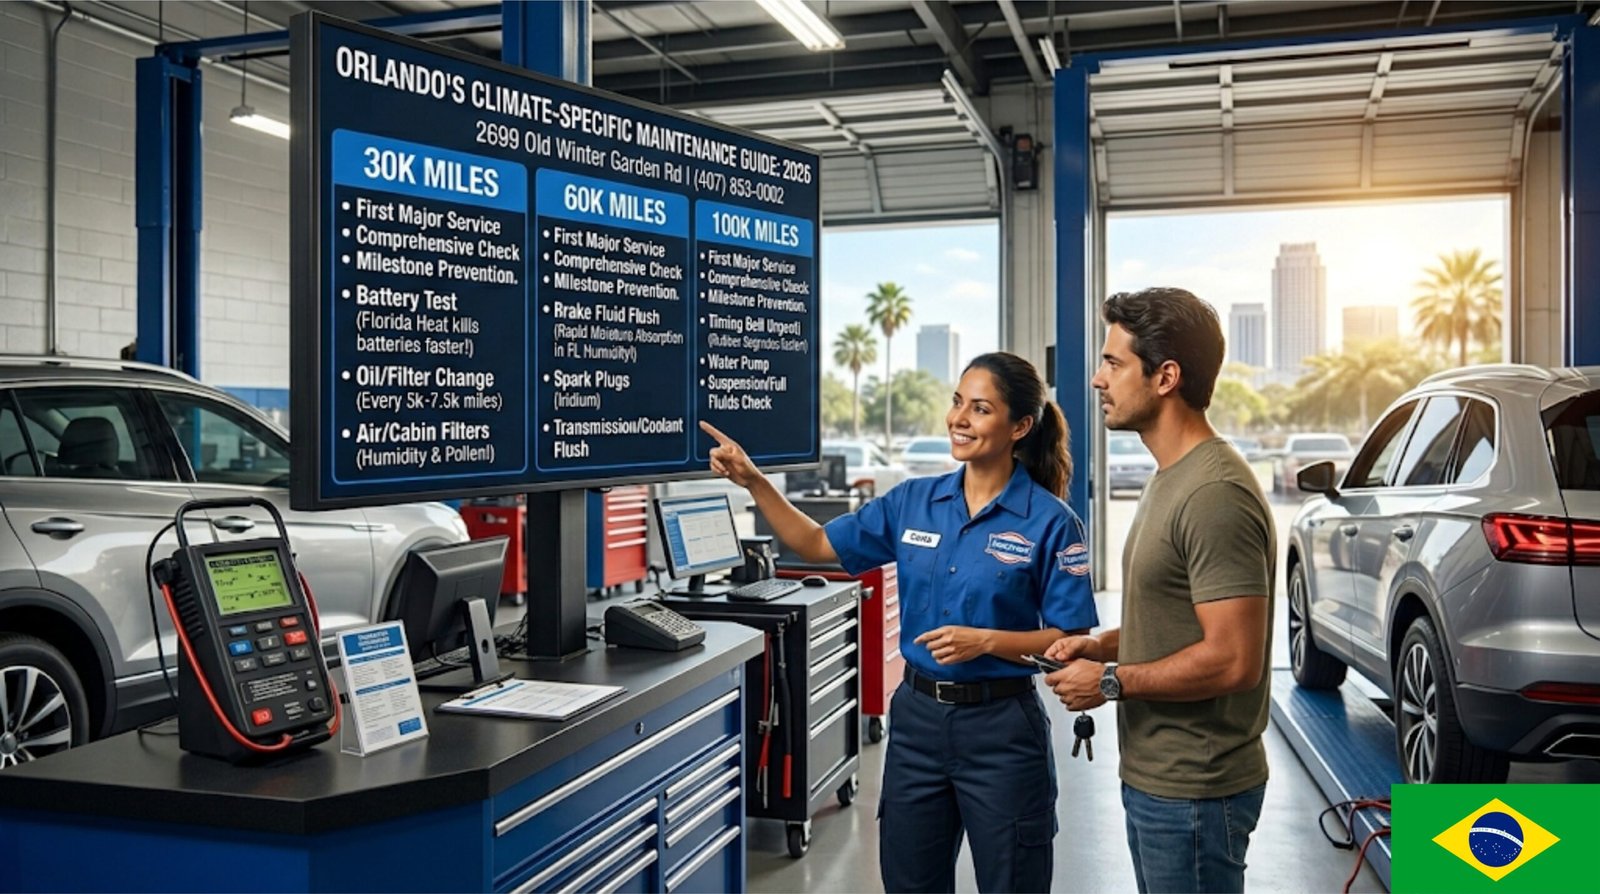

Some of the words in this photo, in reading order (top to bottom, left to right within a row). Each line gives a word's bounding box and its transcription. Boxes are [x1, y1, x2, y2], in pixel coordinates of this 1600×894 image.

[336, 46, 465, 104] ORLANDO'S
[472, 80, 632, 142] CLIMATE-SPECIFIC
[637, 122, 737, 167] MAINTENANCE
[740, 148, 780, 177] GUIDE:
[783, 159, 811, 184] 2026
[364, 147, 416, 184] 30K
[424, 157, 499, 197] MILES
[476, 120, 519, 150] 2699
[525, 131, 551, 156] Old
[556, 137, 606, 167] Winter
[611, 150, 660, 179] Garden
[664, 162, 682, 183] Rd
[694, 169, 726, 194] (407)
[729, 177, 784, 204] 853-0002
[357, 197, 394, 221] First
[399, 203, 444, 228] Major
[447, 211, 501, 235] Service
[564, 184, 604, 215] 60K
[609, 192, 666, 225] MILES
[554, 226, 583, 247] First
[586, 231, 621, 252] Major
[623, 237, 665, 258] Service
[712, 211, 751, 239] 100K
[755, 219, 799, 247] MILES
[356, 226, 474, 256] Comprehensive
[478, 239, 520, 261] Check
[357, 251, 433, 277] Milestone
[438, 259, 518, 284] Prevention.
[554, 250, 646, 276] Comprehensive
[649, 261, 682, 280] Check
[357, 284, 419, 312] Battery
[423, 290, 458, 311] Test
[554, 272, 614, 294] Milestone
[617, 278, 679, 300] Prevention.
[356, 310, 412, 332] (Florida
[417, 314, 449, 333] Heat
[554, 301, 592, 320] Brake
[595, 304, 626, 323] Fluid
[628, 307, 660, 325] Flush
[357, 334, 421, 353] batteries
[554, 323, 588, 341] (Rapid
[554, 342, 564, 357] in
[567, 343, 581, 359] FL
[356, 365, 431, 387] Oil/Filter
[435, 367, 494, 391] Change
[554, 369, 592, 390] Spark
[595, 370, 630, 391] Plugs
[356, 391, 402, 413] (Every
[406, 392, 460, 409] 5k-7.5k
[464, 392, 502, 412] miles)
[554, 392, 601, 411] (Iridium)
[356, 423, 436, 443] Air/Cabin
[441, 423, 490, 440] Filters
[554, 417, 683, 435] Transmission/Coolant
[356, 447, 427, 470] (Humidity
[431, 446, 441, 463] &
[554, 440, 589, 458] Flush
